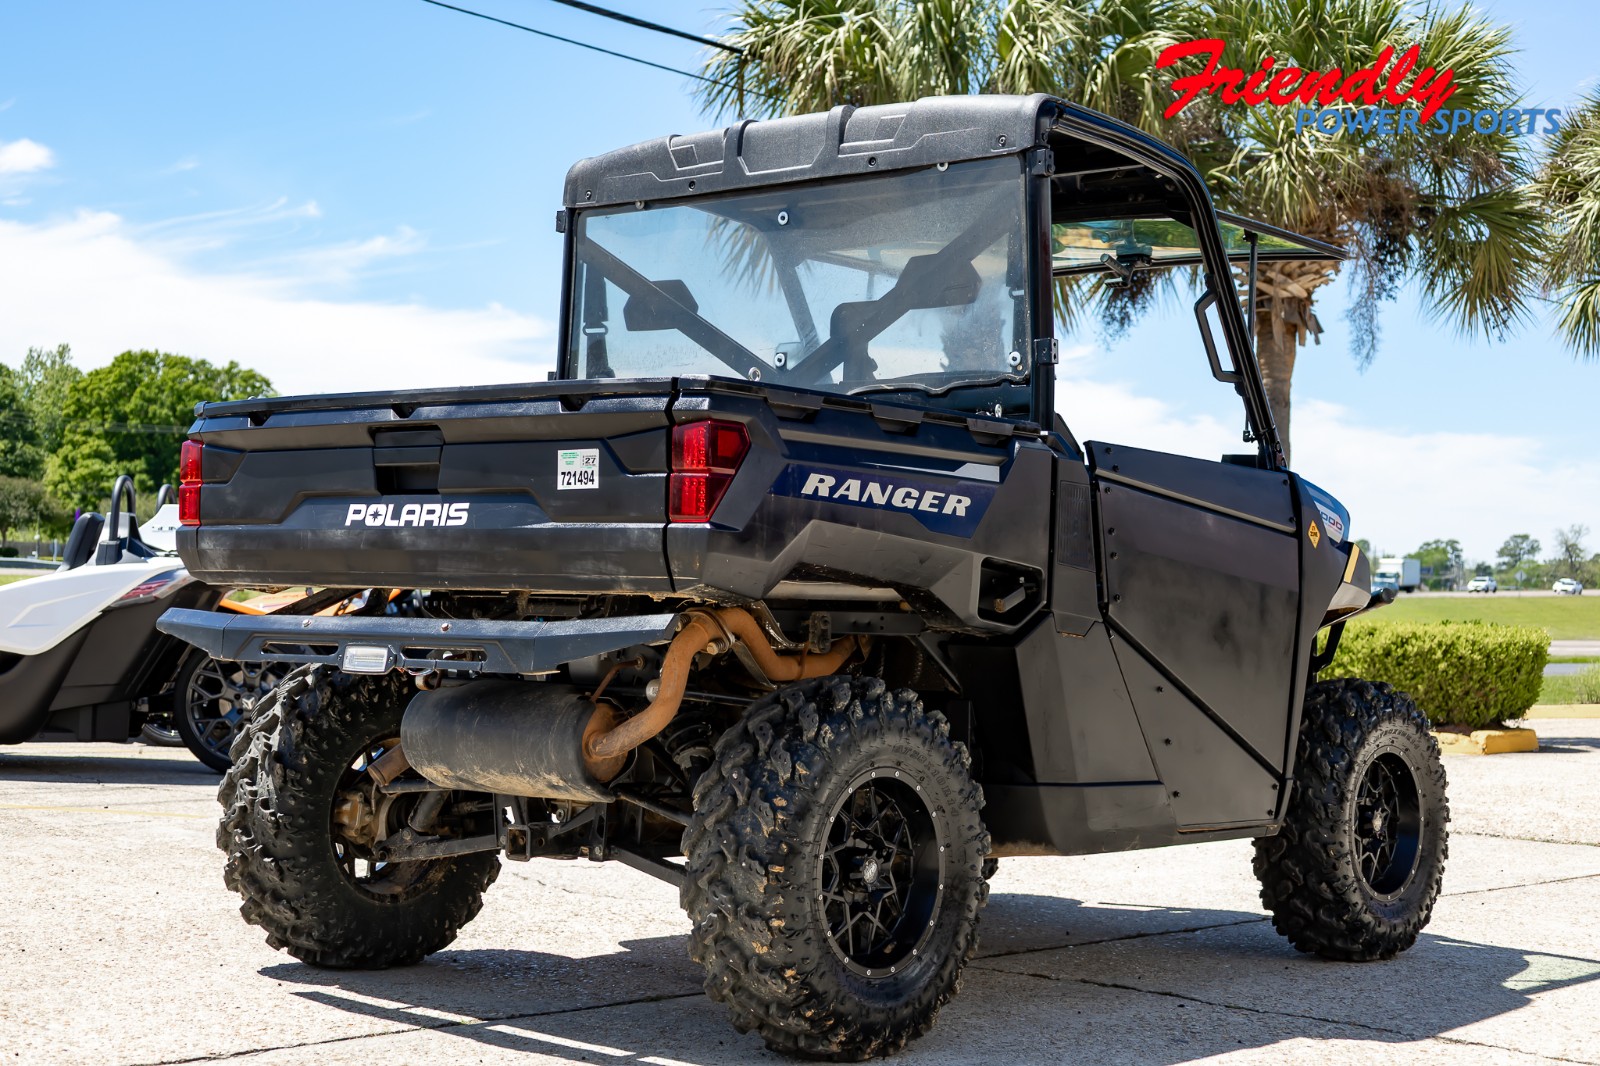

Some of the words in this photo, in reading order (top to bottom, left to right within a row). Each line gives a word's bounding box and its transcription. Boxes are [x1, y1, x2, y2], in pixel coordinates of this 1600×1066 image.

[561, 470, 594, 485] 721494
[801, 473, 972, 517] RANGER
[345, 502, 470, 527] POLARIS
